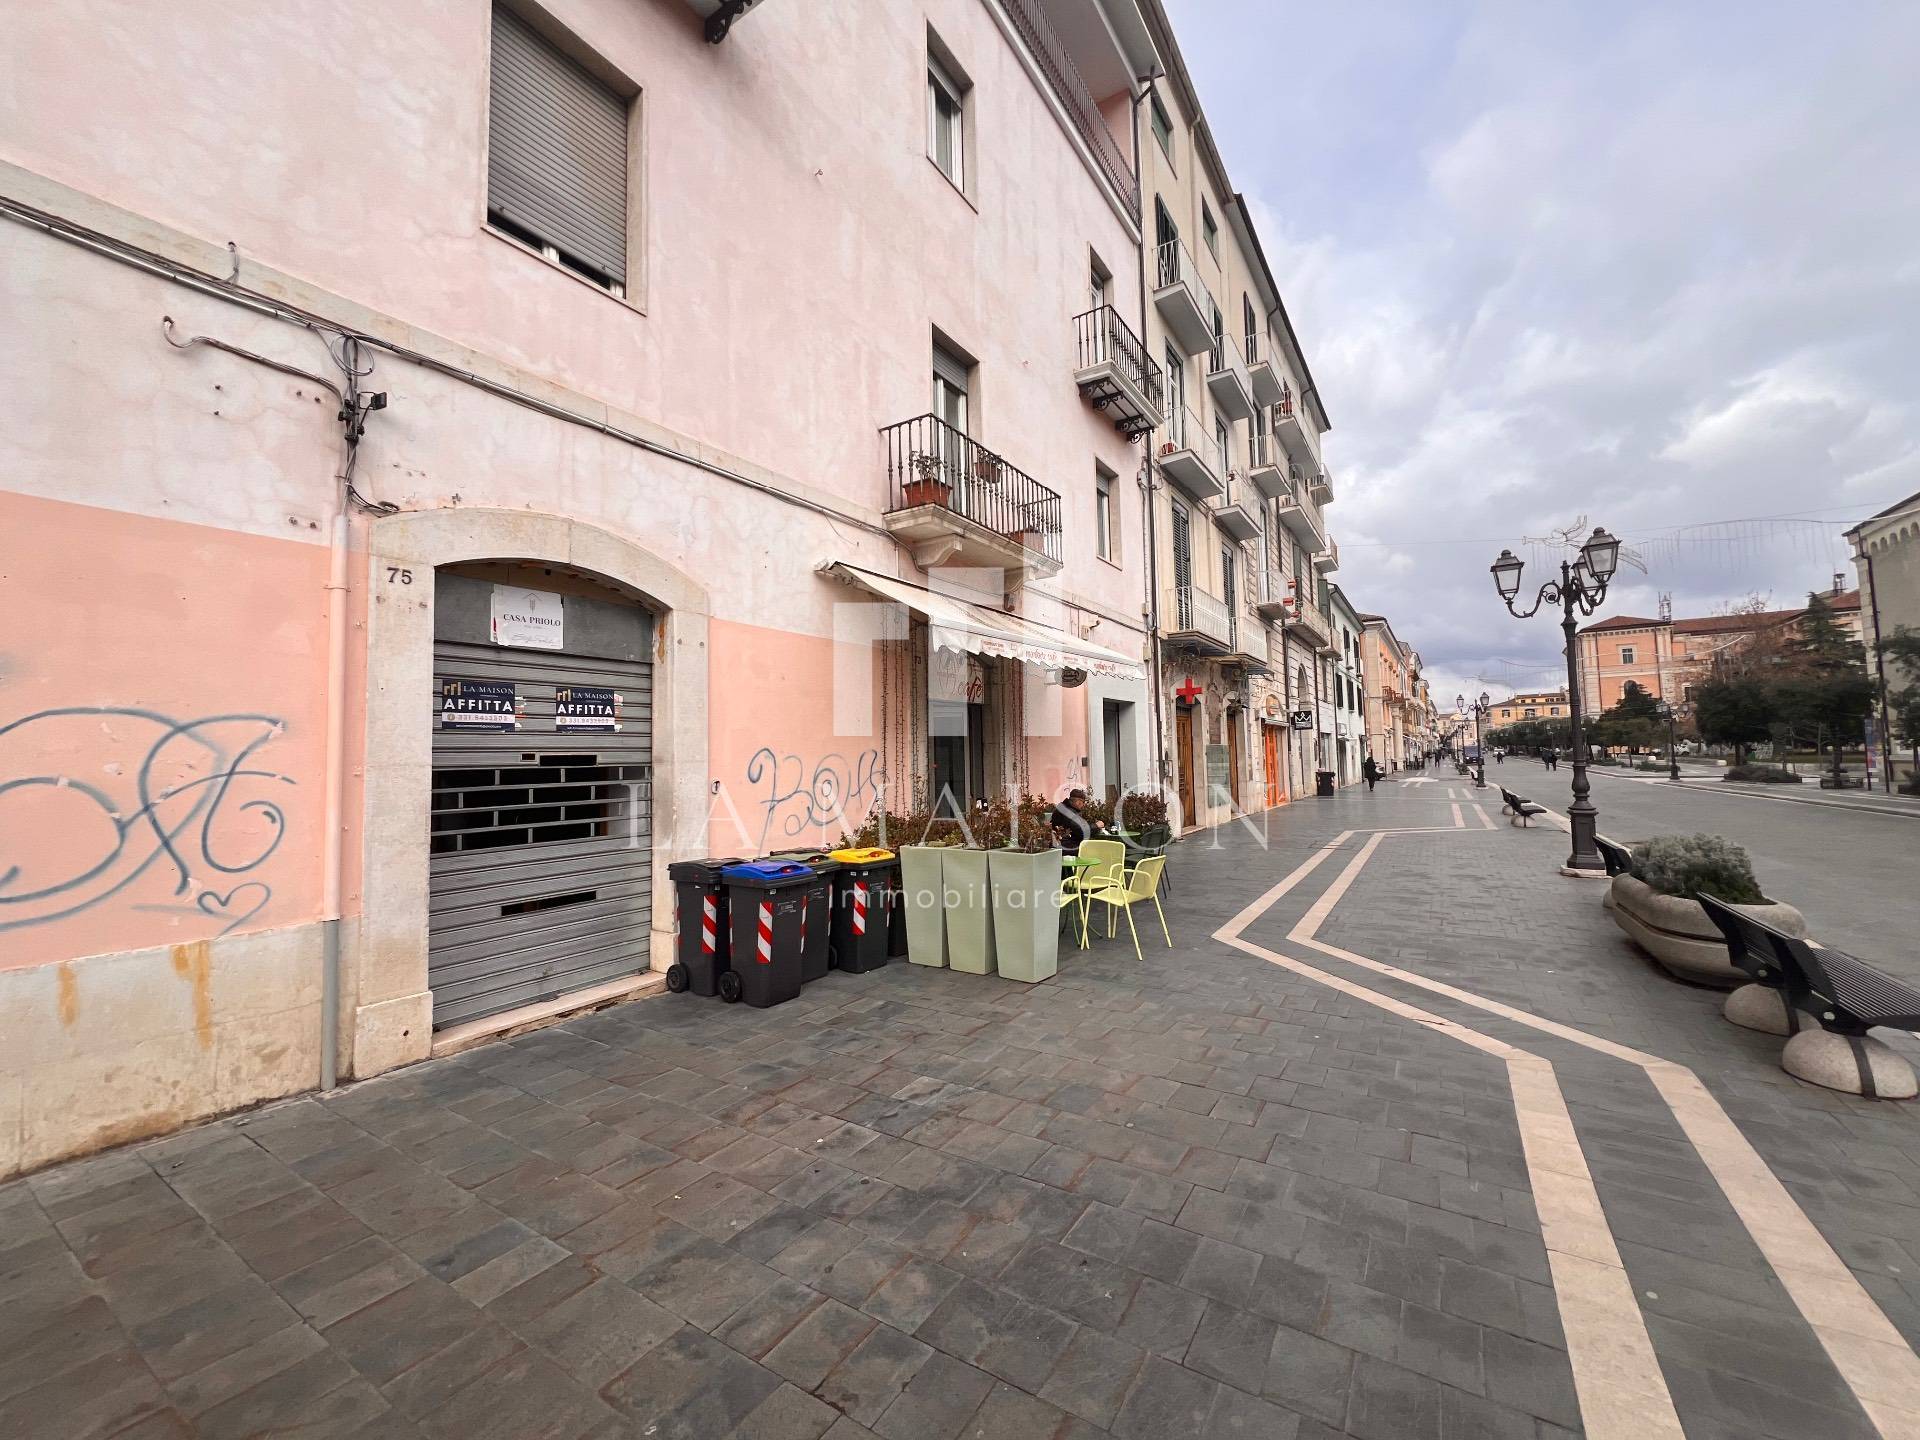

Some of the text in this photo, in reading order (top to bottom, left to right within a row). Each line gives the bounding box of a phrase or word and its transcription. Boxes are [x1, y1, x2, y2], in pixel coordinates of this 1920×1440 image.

[386, 566, 413, 585] 75
[503, 613, 527, 625] CASA
[529, 616, 561, 628] PRIOLO
[463, 685, 514, 695] LA MAISON
[584, 692, 614, 700] MAISON
[443, 698, 513, 712] AFFITTA
[557, 703, 613, 715] AFFITTA
